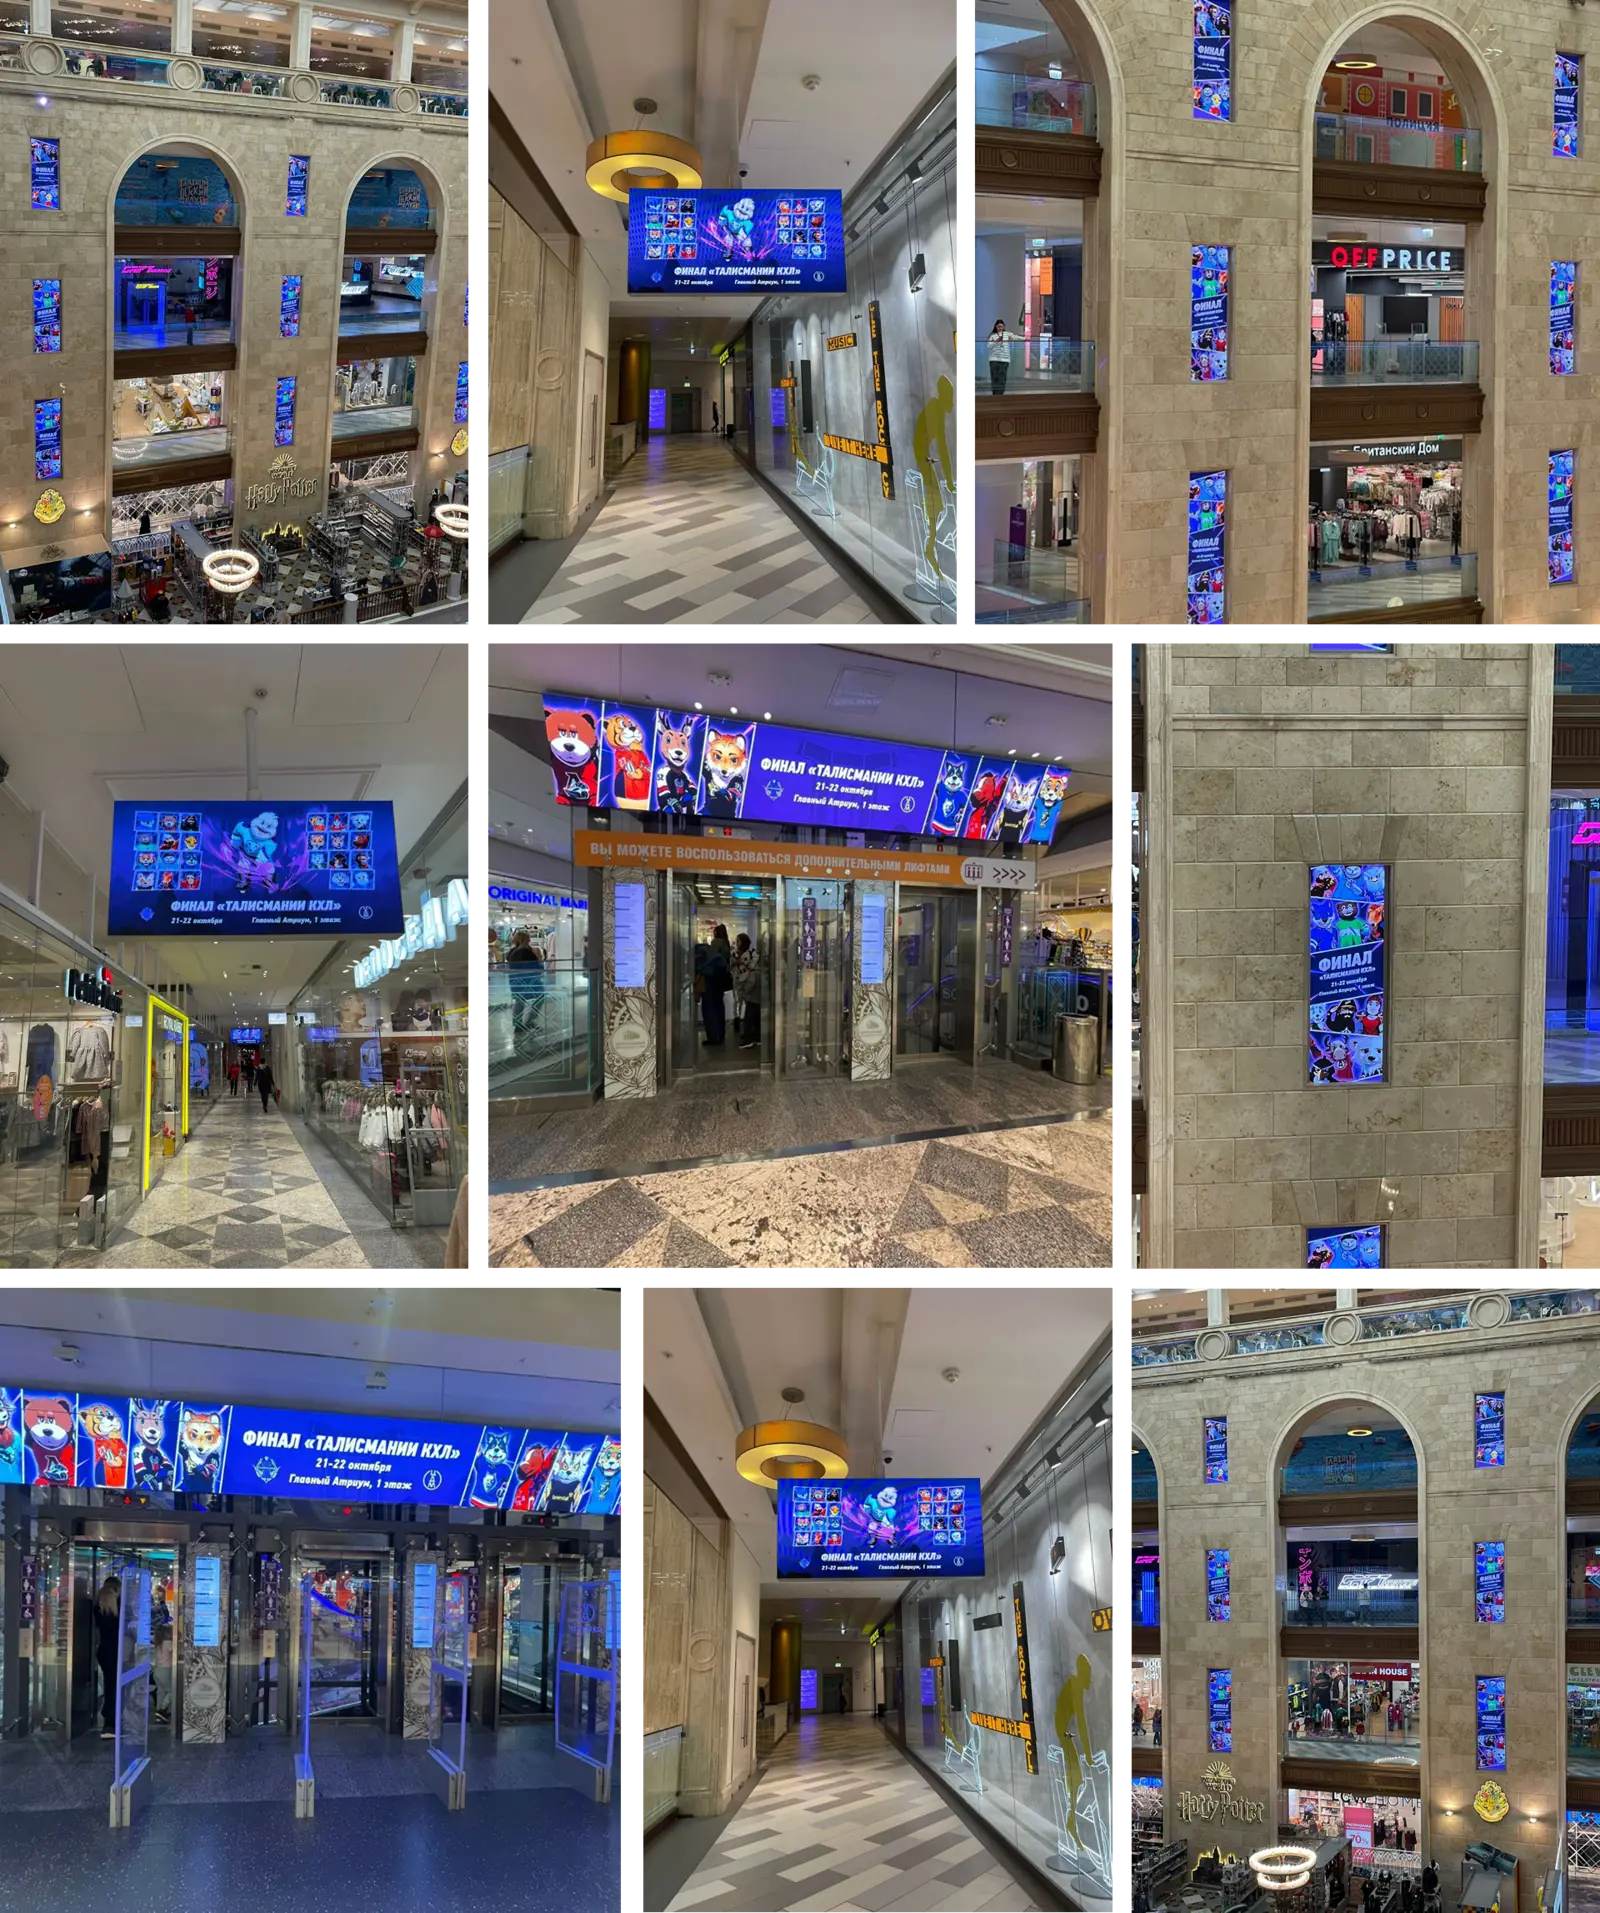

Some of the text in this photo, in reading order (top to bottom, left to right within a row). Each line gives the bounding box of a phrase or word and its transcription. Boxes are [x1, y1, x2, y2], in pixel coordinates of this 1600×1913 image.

[1197, 45, 1225, 57] ФИНАЛ
[673, 266, 706, 275] ФИНАЛ
[1194, 299, 1222, 312] ФИНАЛ
[872, 351, 881, 391] THE
[876, 400, 886, 446] ROC
[1417, 442, 1440, 455] Дом
[1192, 537, 1220, 548] ФИНАЛ
[760, 757, 925, 788] ФИНАЛ «ТАЛИСМАНИИ КХЛ»
[815, 782, 873, 797] 21-22 октября
[793, 794, 890, 811] Главный Атриум, 1 этаж
[590, 842, 950, 875] ВЫ МОЖЕТЕ ВОСПОЛЬЗОВАТЬСЯ ДОПОЛНИТЕЛЬНЫМИ ЛИФТАМИ
[488, 885, 559, 907] ORIGINAL
[170, 899, 342, 912] ФИНАЛ «ТАЛИСМАНИИ КХЛ»
[193, 917, 223, 925] октября
[282, 917, 312, 925] Атриум,
[1318, 950, 1372, 972] ФИНАЛ
[242, 1429, 461, 1460] ФИНАЛ «ТАЛИСМАНИИ КХЛ»
[315, 1457, 391, 1474] 21-22 октября
[289, 1473, 412, 1490] Главный Атриум, 1 этаж
[820, 1552, 942, 1562] ФИНАЛ «ТАЛИСМАНИИ КХЛ»
[1014, 1598, 1023, 1637] THE
[1018, 1645, 1028, 1700] ROCK
[1379, 1667, 1408, 1676] HOUSE
[1177, 1790, 1265, 1826] Harry Potter
